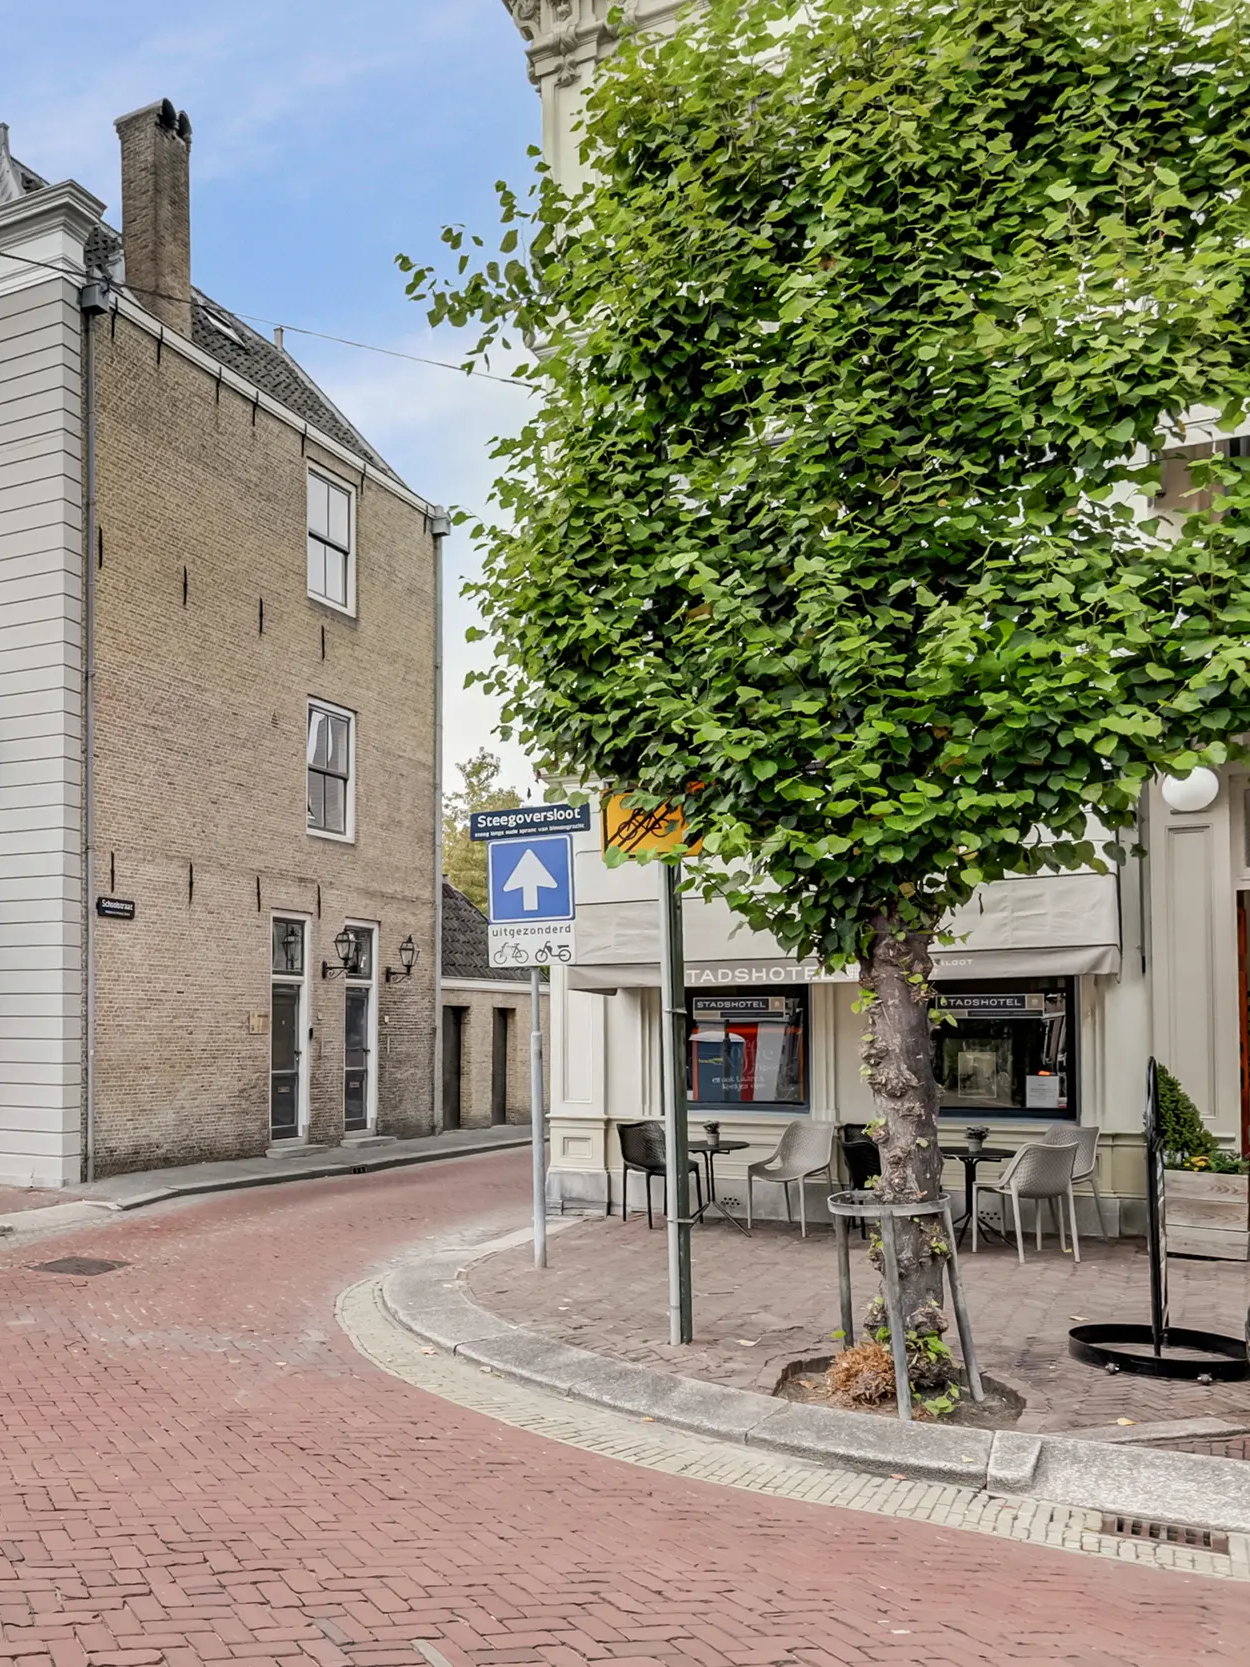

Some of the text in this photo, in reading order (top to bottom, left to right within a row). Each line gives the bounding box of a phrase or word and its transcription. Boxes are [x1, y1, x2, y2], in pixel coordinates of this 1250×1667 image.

[477, 808, 581, 828] Steegoversloot
[492, 924, 571, 938] uitgezonderd
[686, 966, 835, 984] TADSHOTEL
[697, 1000, 767, 1009] STADSHOTEL
